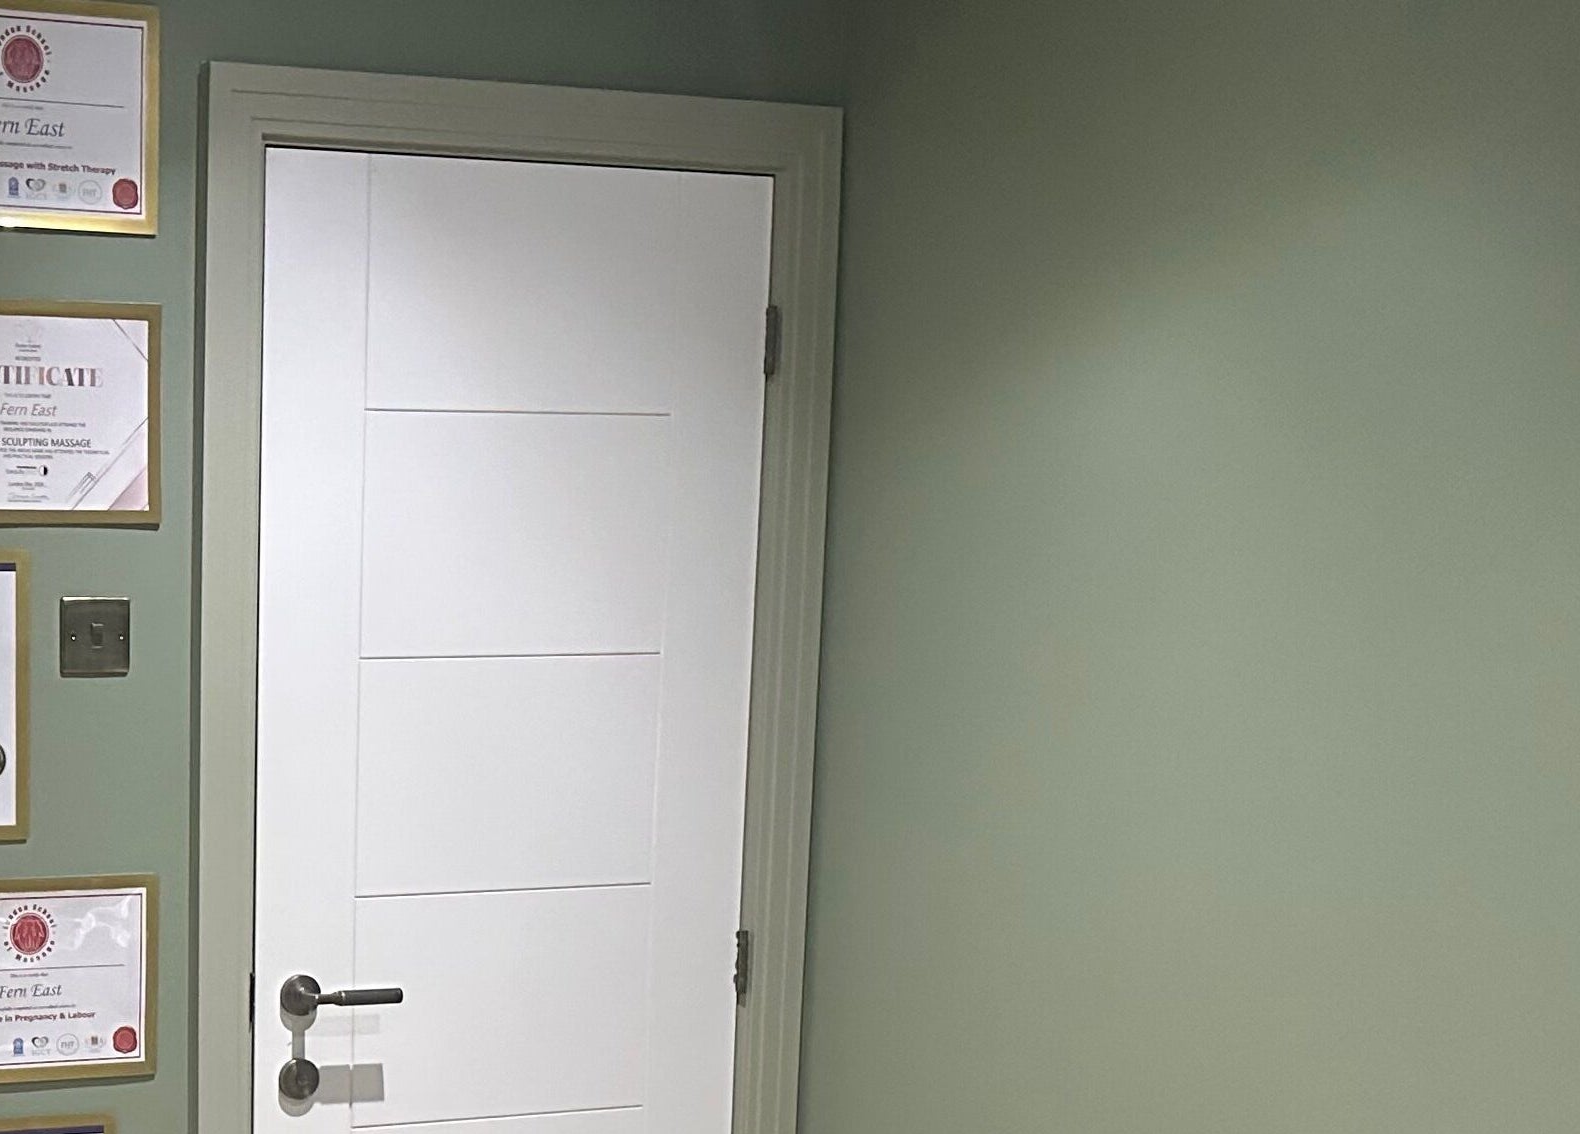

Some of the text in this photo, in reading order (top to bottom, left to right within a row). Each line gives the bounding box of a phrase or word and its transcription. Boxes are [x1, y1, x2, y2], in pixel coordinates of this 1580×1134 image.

[24, 118, 66, 138] East
[26, 162, 46, 170] with
[48, 163, 80, 172] Stretch
[82, 165, 116, 175] Therapy
[0, 403, 58, 417] Fern East
[2, 437, 48, 447] SCULPTING
[51, 438, 92, 448] MASSAGE
[30, 984, 62, 997] East
[5, 1014, 12, 1022] in
[15, 1014, 57, 1022] Pregnancy
[68, 1011, 96, 1019] Labour
